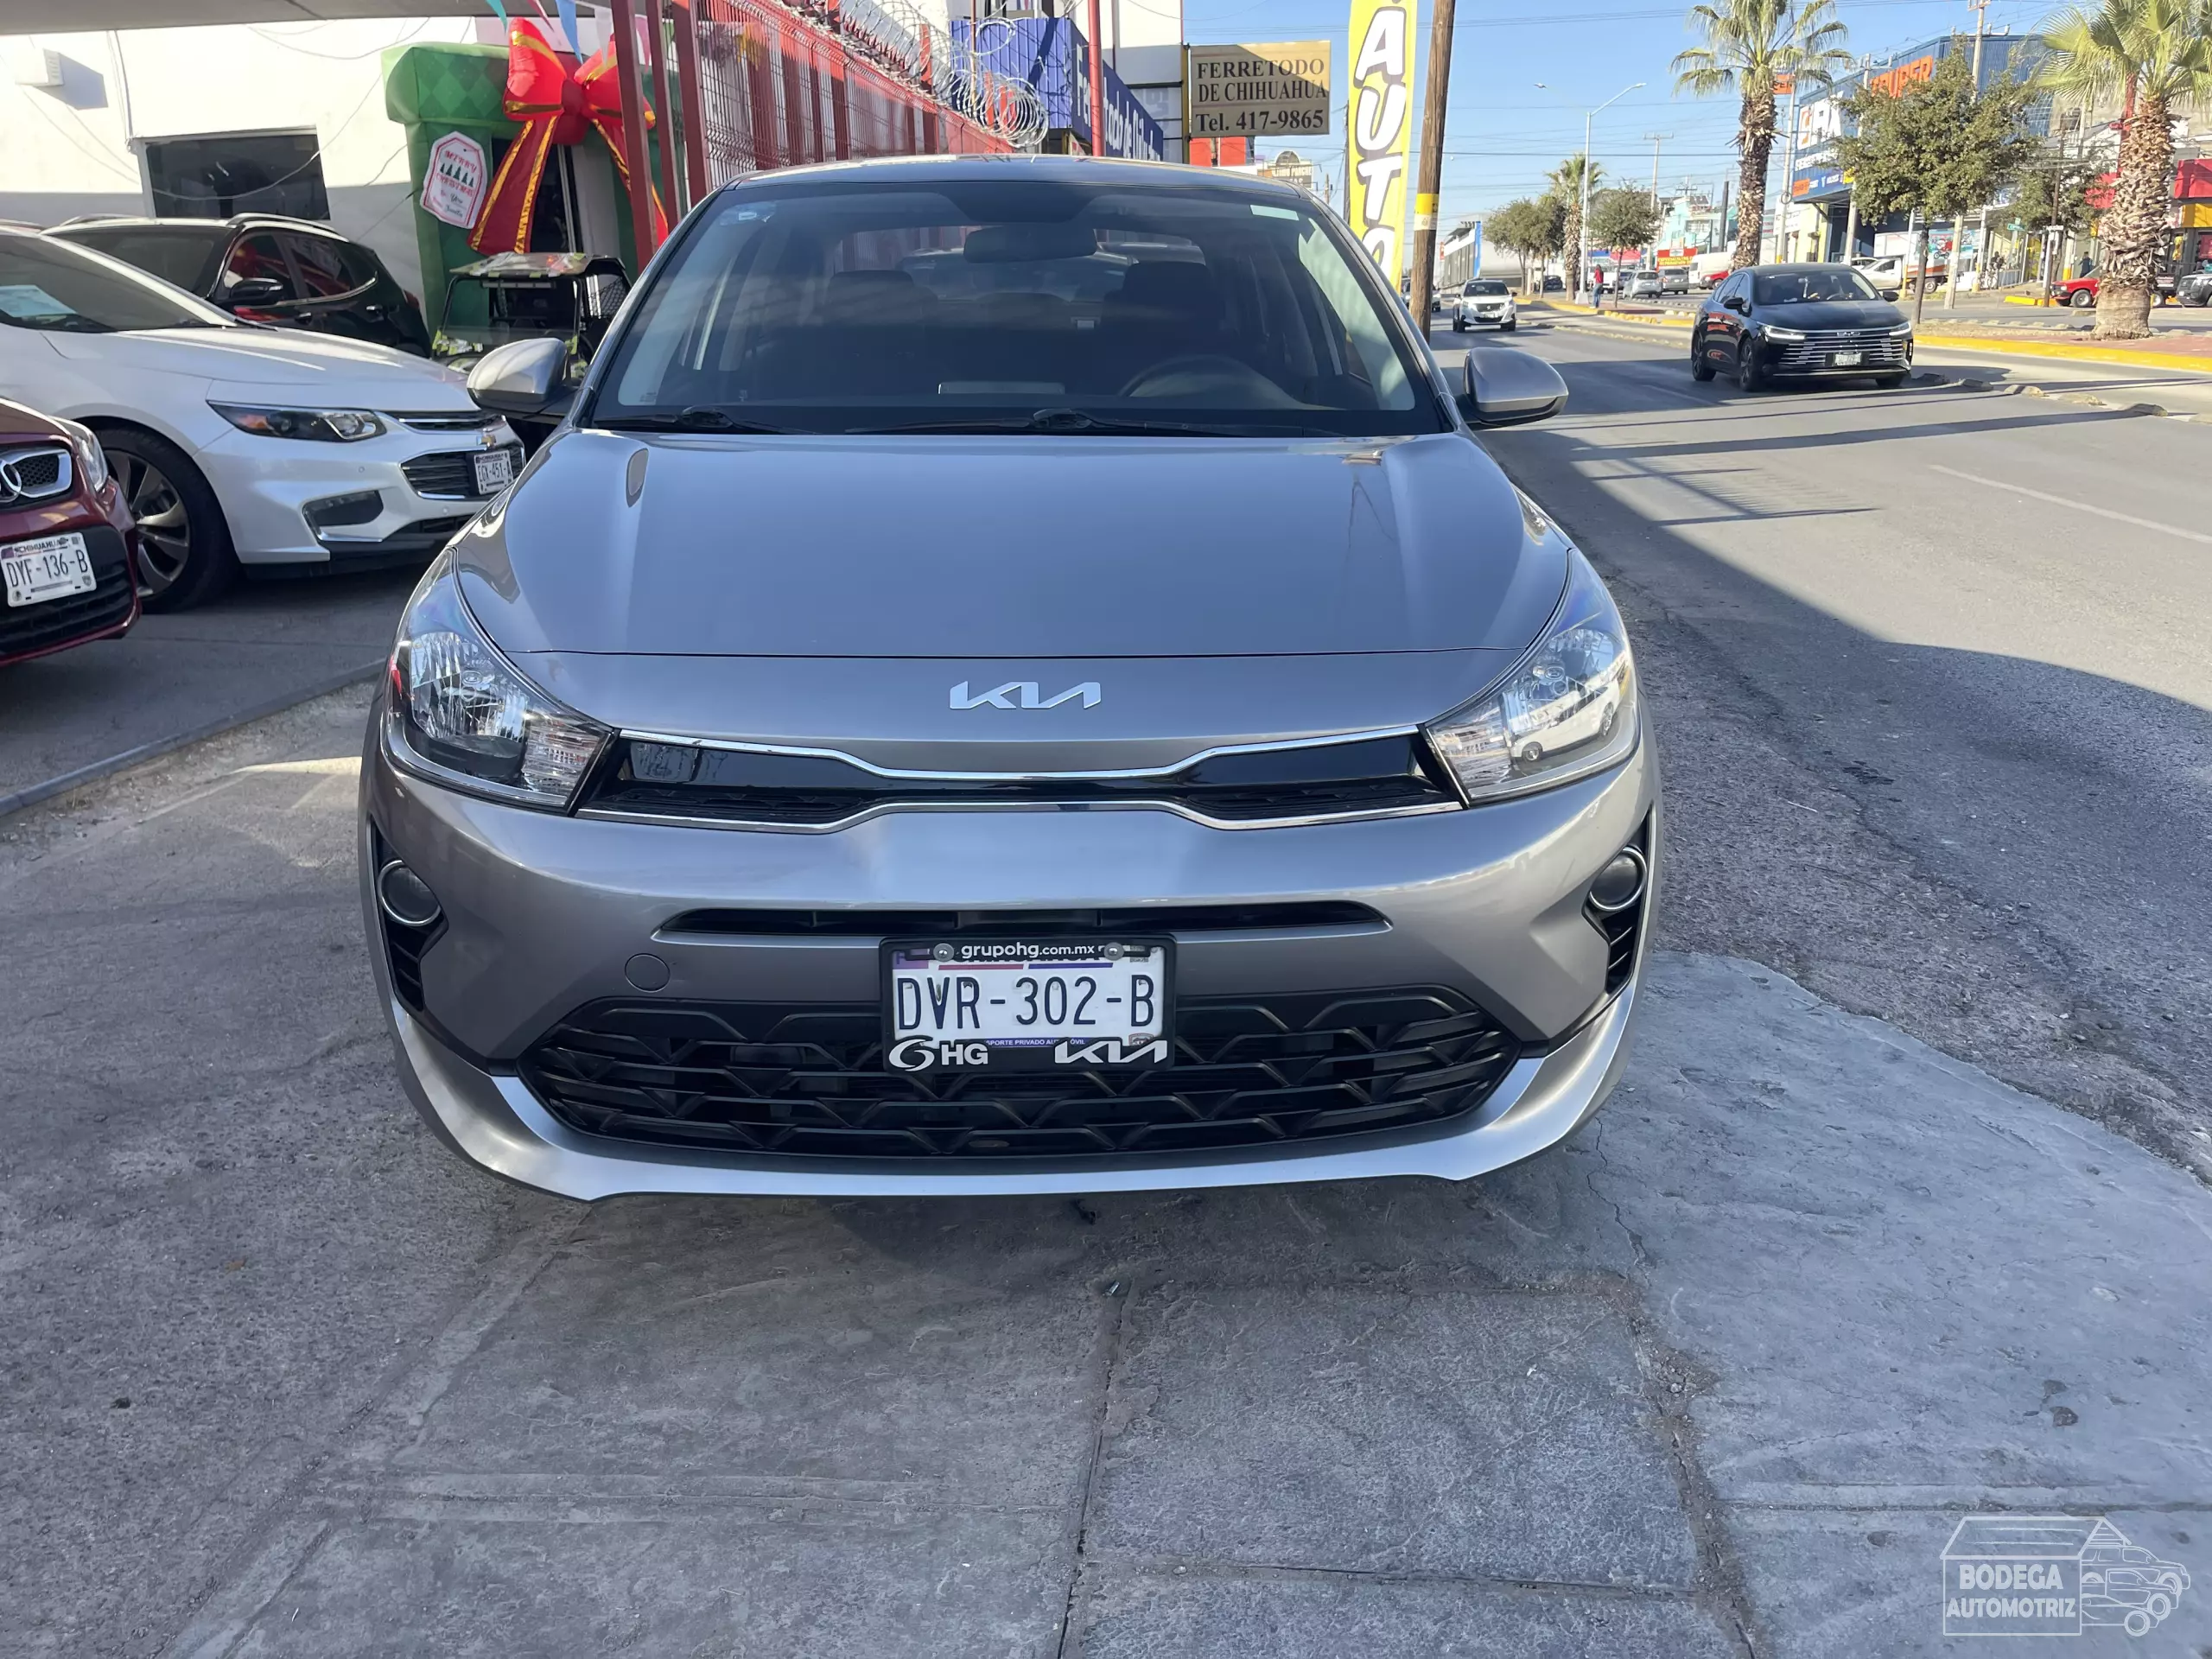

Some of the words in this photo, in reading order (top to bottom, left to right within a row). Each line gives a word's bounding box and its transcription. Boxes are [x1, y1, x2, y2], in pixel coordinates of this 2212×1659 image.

[1197, 59, 1325, 79] FERRETODO
[1198, 84, 1220, 102] DE
[1224, 79, 1326, 101] CHIHUAHUA
[1196, 113, 1230, 131] Tel.
[1236, 110, 1324, 130] 417-9865
[6, 550, 88, 588] DYF-136-B
[950, 681, 1102, 709] KIA
[962, 943, 1095, 958] grupohg.com.mx
[897, 975, 1154, 1030] DVR-302-B
[1055, 1039, 1167, 1064] KIA
